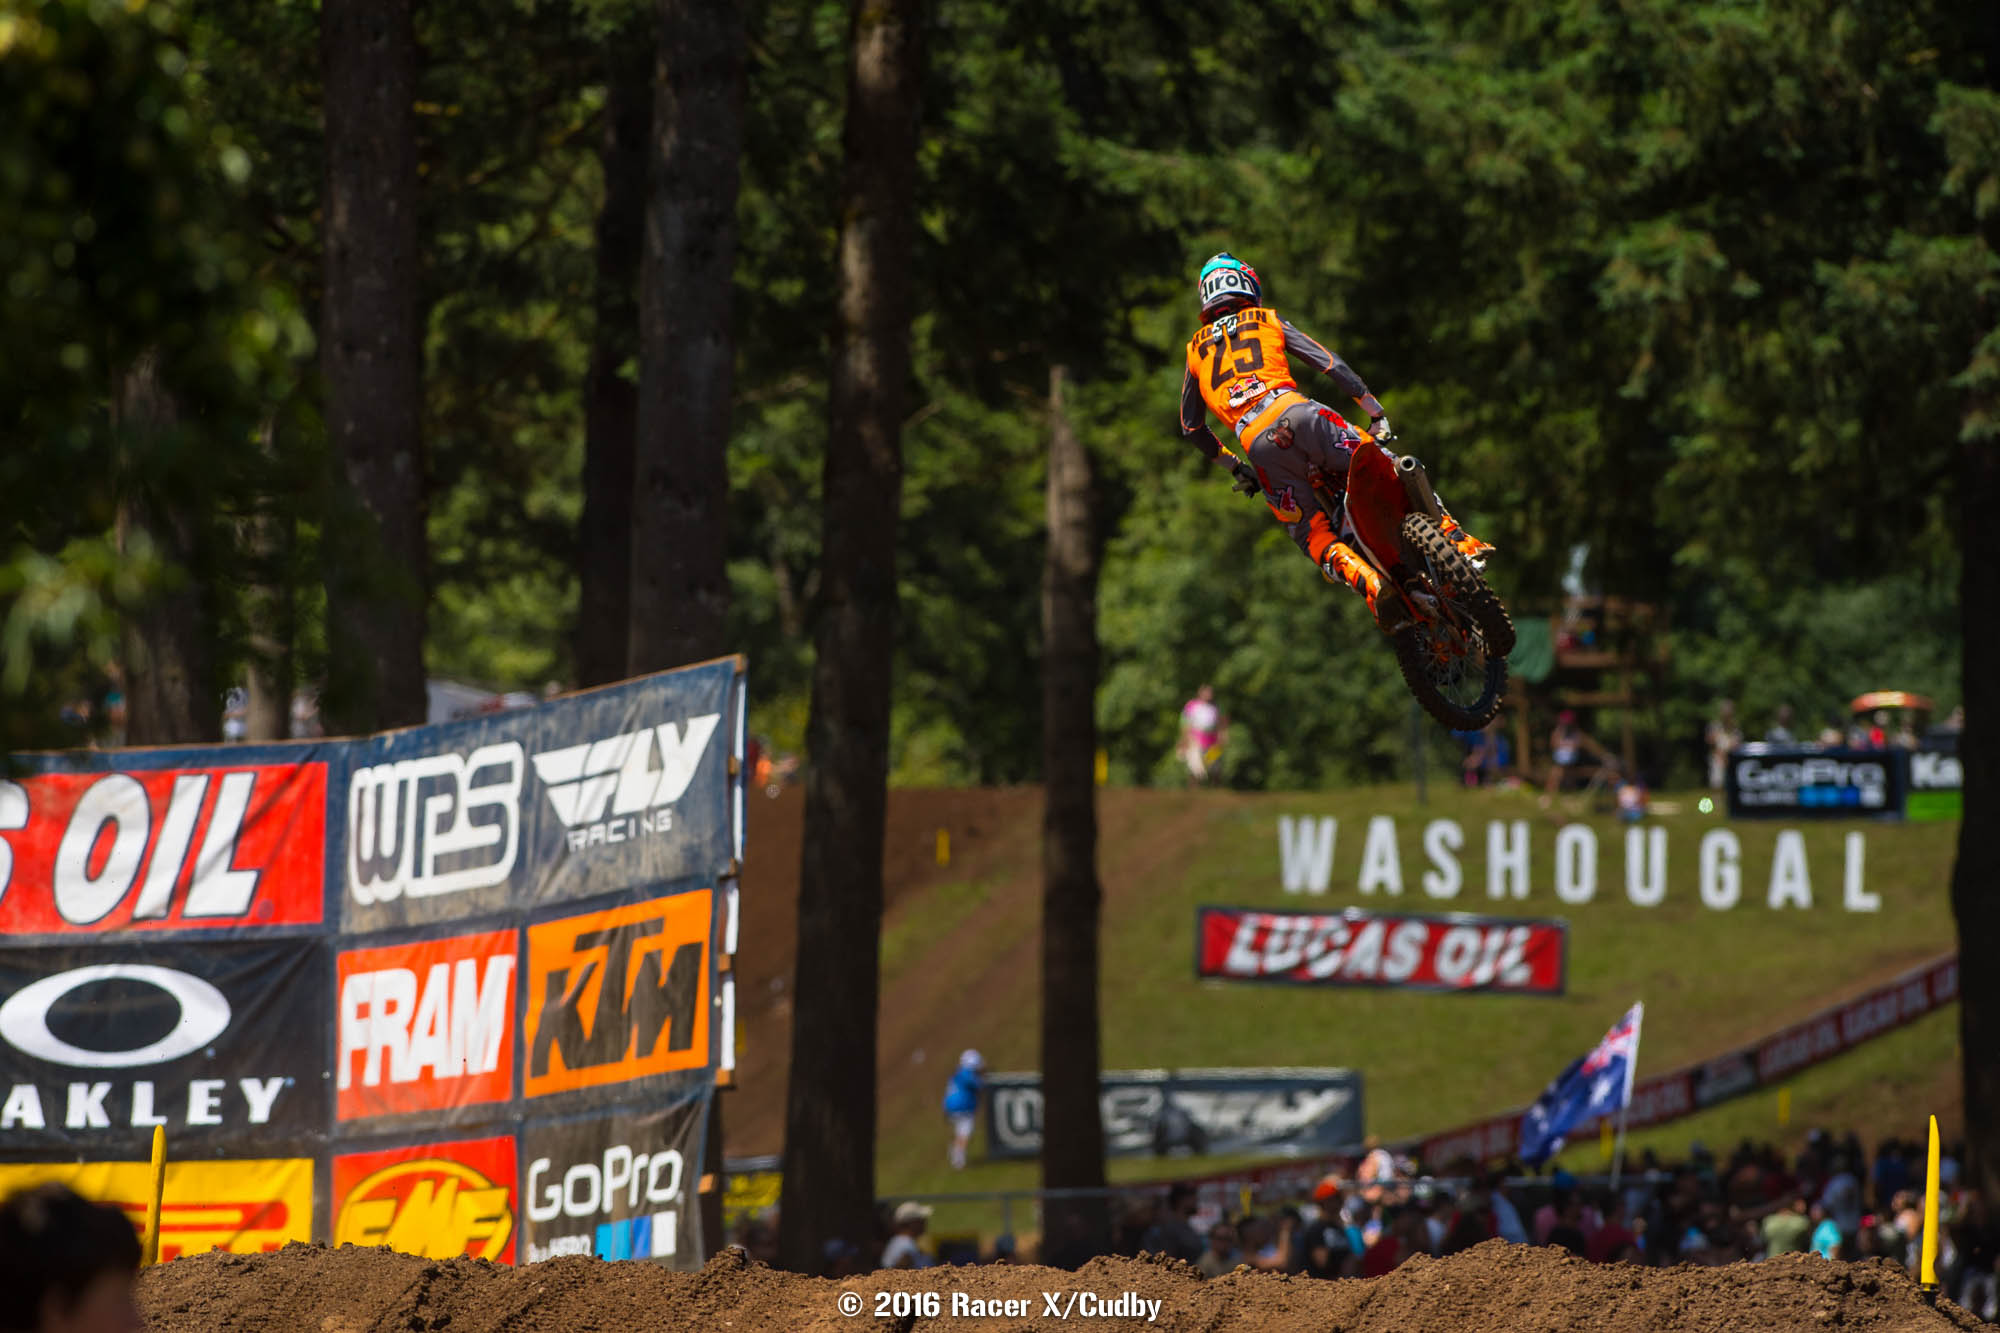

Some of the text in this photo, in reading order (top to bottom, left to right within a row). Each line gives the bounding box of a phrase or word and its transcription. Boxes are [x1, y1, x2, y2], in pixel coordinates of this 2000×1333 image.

[1200, 323, 1264, 391] 25
[532, 712, 721, 828] FLY
[1736, 758, 1886, 791] GoPro
[53, 772, 261, 926] OIL
[348, 741, 525, 906] WPS
[567, 808, 674, 854] RACING
[1278, 813, 1881, 912] WASHOUGAL
[1224, 913, 1533, 987] LUCAS OIL
[337, 954, 516, 1090] FRAM
[530, 917, 703, 1079] KTM
[0, 1077, 284, 1129] AKLEY
[528, 1144, 683, 1222] GoPro
